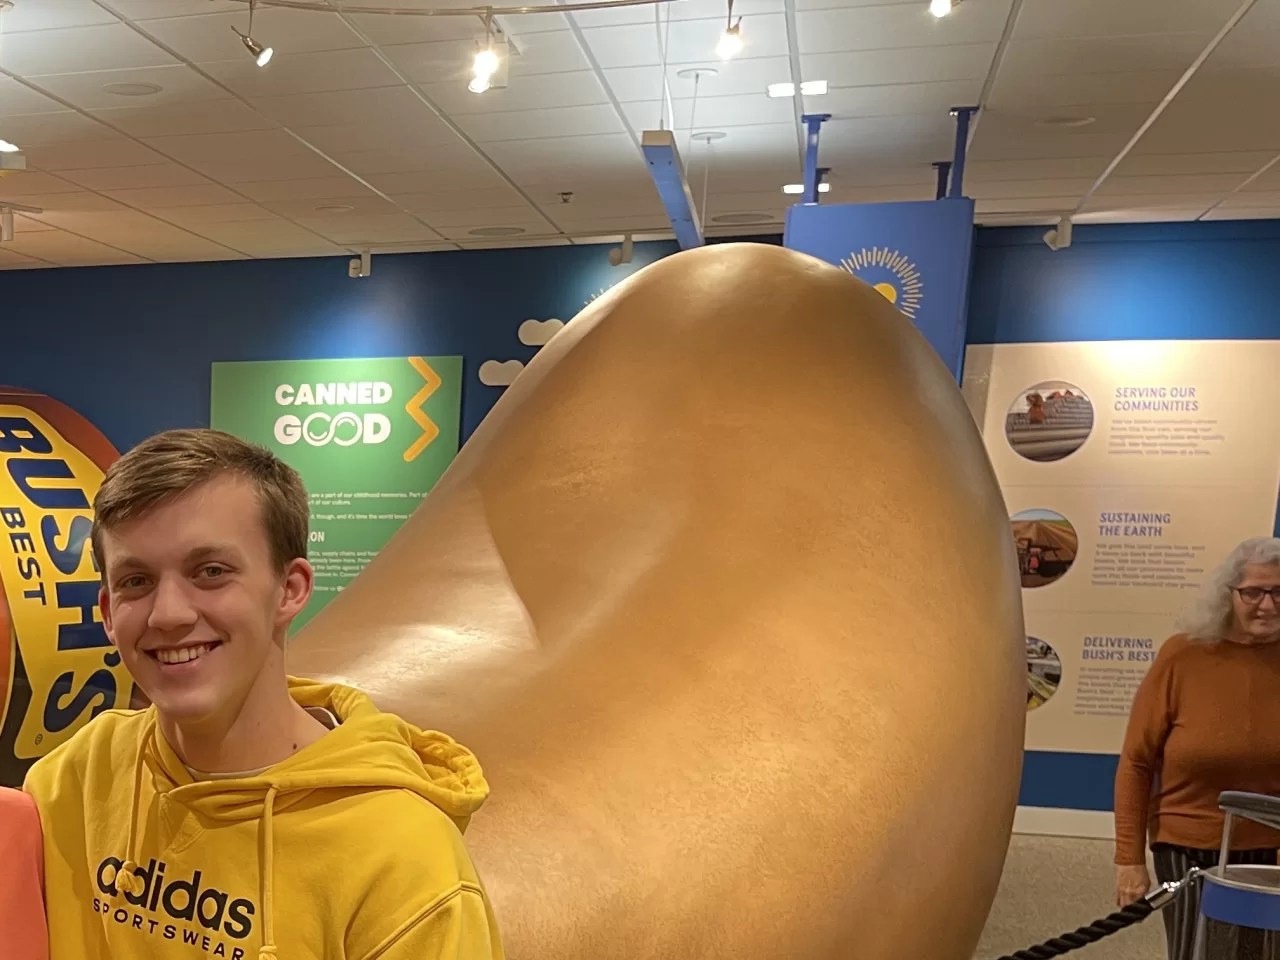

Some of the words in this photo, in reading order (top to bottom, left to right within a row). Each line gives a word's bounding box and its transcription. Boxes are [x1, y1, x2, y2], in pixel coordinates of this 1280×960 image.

[274, 381, 393, 406] CANNED
[1115, 387, 1166, 398] SERVING
[1170, 387, 1196, 398] OUR
[1114, 400, 1199, 411] COMMUNITIES
[273, 411, 392, 447] GOOD
[1100, 512, 1171, 524] SUSTAINING
[1098, 525, 1120, 536] THE
[1123, 526, 1162, 537] EARTH
[0, 506, 46, 606] BEST
[1083, 636, 1152, 649] DELIVERING
[1082, 649, 1124, 661] BUSH'S
[1127, 650, 1156, 662] BEST
[96, 856, 255, 940] adidas
